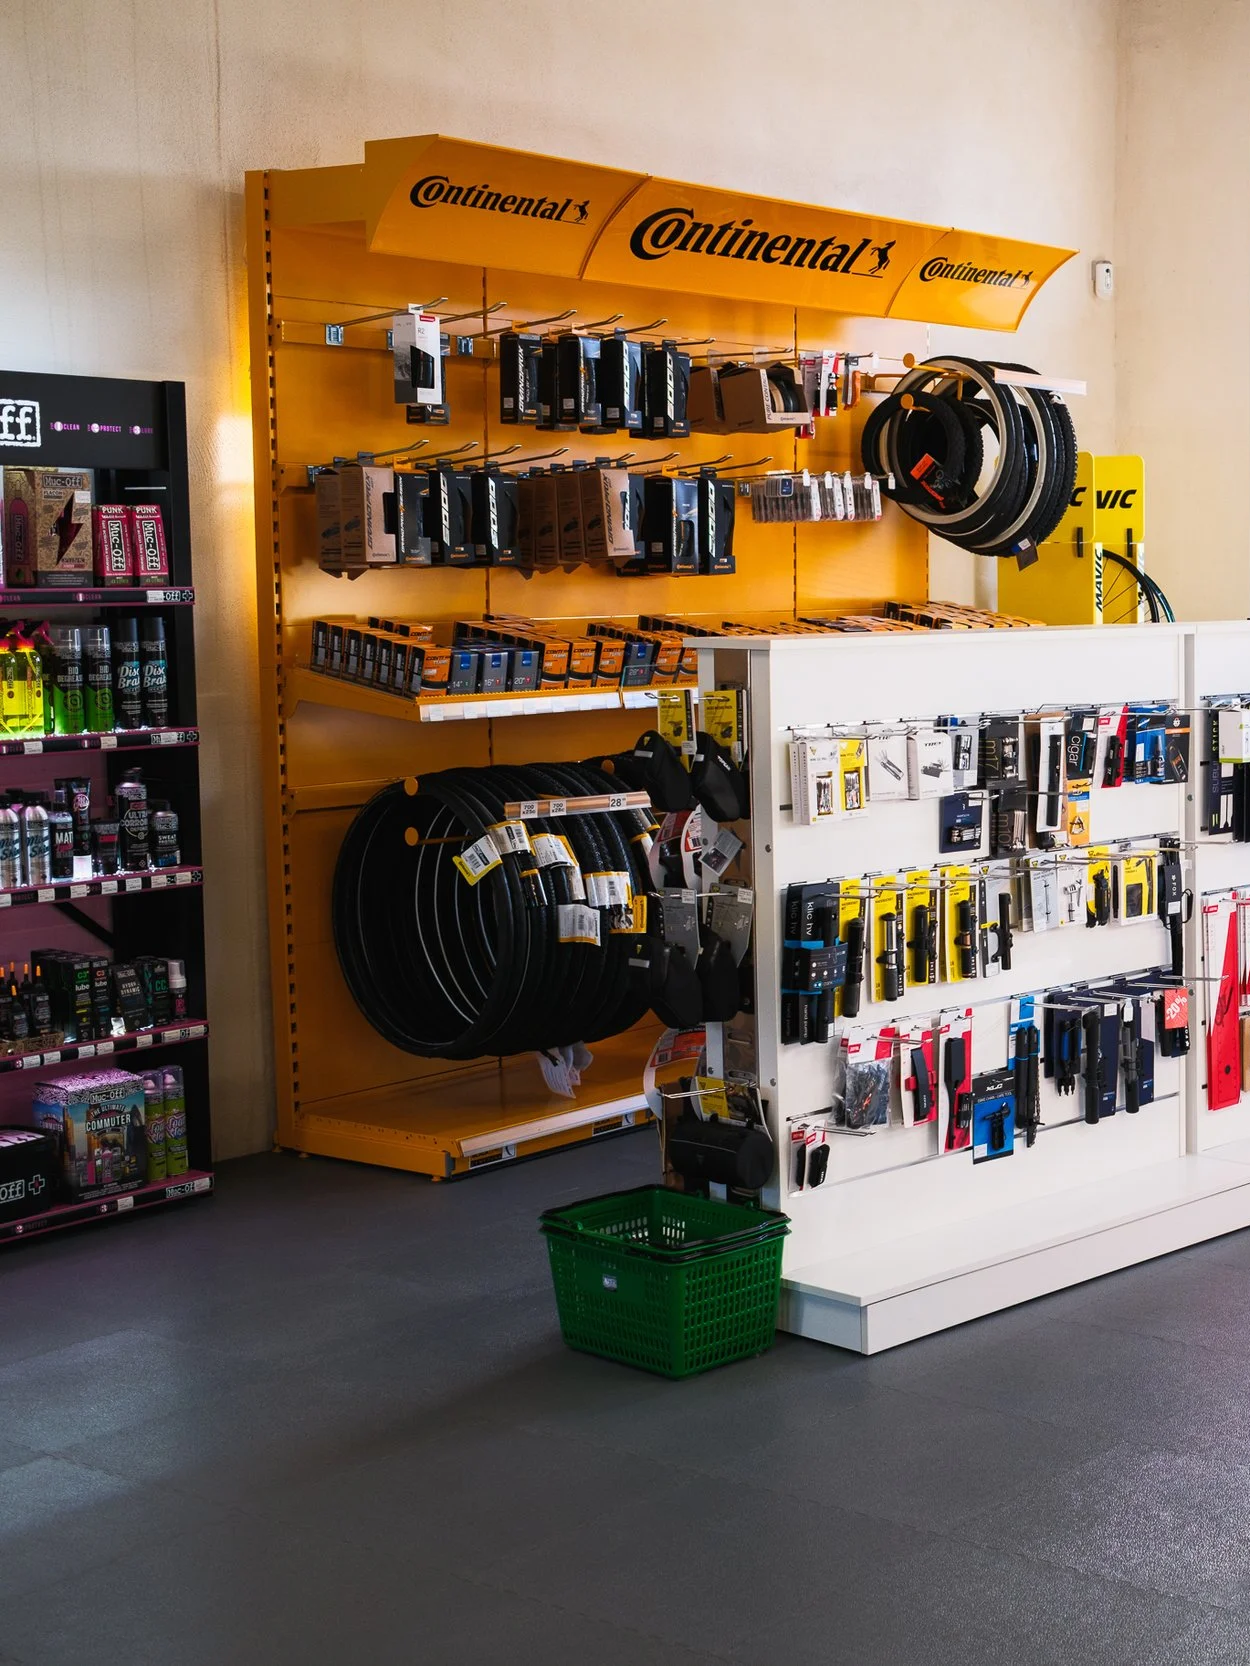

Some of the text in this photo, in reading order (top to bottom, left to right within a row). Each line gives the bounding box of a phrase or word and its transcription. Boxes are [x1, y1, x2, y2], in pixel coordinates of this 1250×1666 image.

[410, 175, 572, 222] Continental
[630, 208, 872, 274] Continental
[919, 256, 1022, 288] Continental
[100, 424, 122, 433] PROTECT
[44, 474, 81, 488] Muc-Off
[110, 522, 125, 569] Muc-Off
[144, 522, 159, 568] Muc-Off
[1095, 549, 1104, 612] MAVIC
[1066, 735, 1081, 767] cigar
[806, 901, 815, 936] klic hv
[75, 983, 90, 992] lube
[94, 980, 107, 988] lube
[1166, 995, 1188, 1021] -20%
[92, 1089, 125, 1103] Muc-Off
[86, 1114, 131, 1132] COMMUTER
[167, 1184, 193, 1198] Muc-Of
